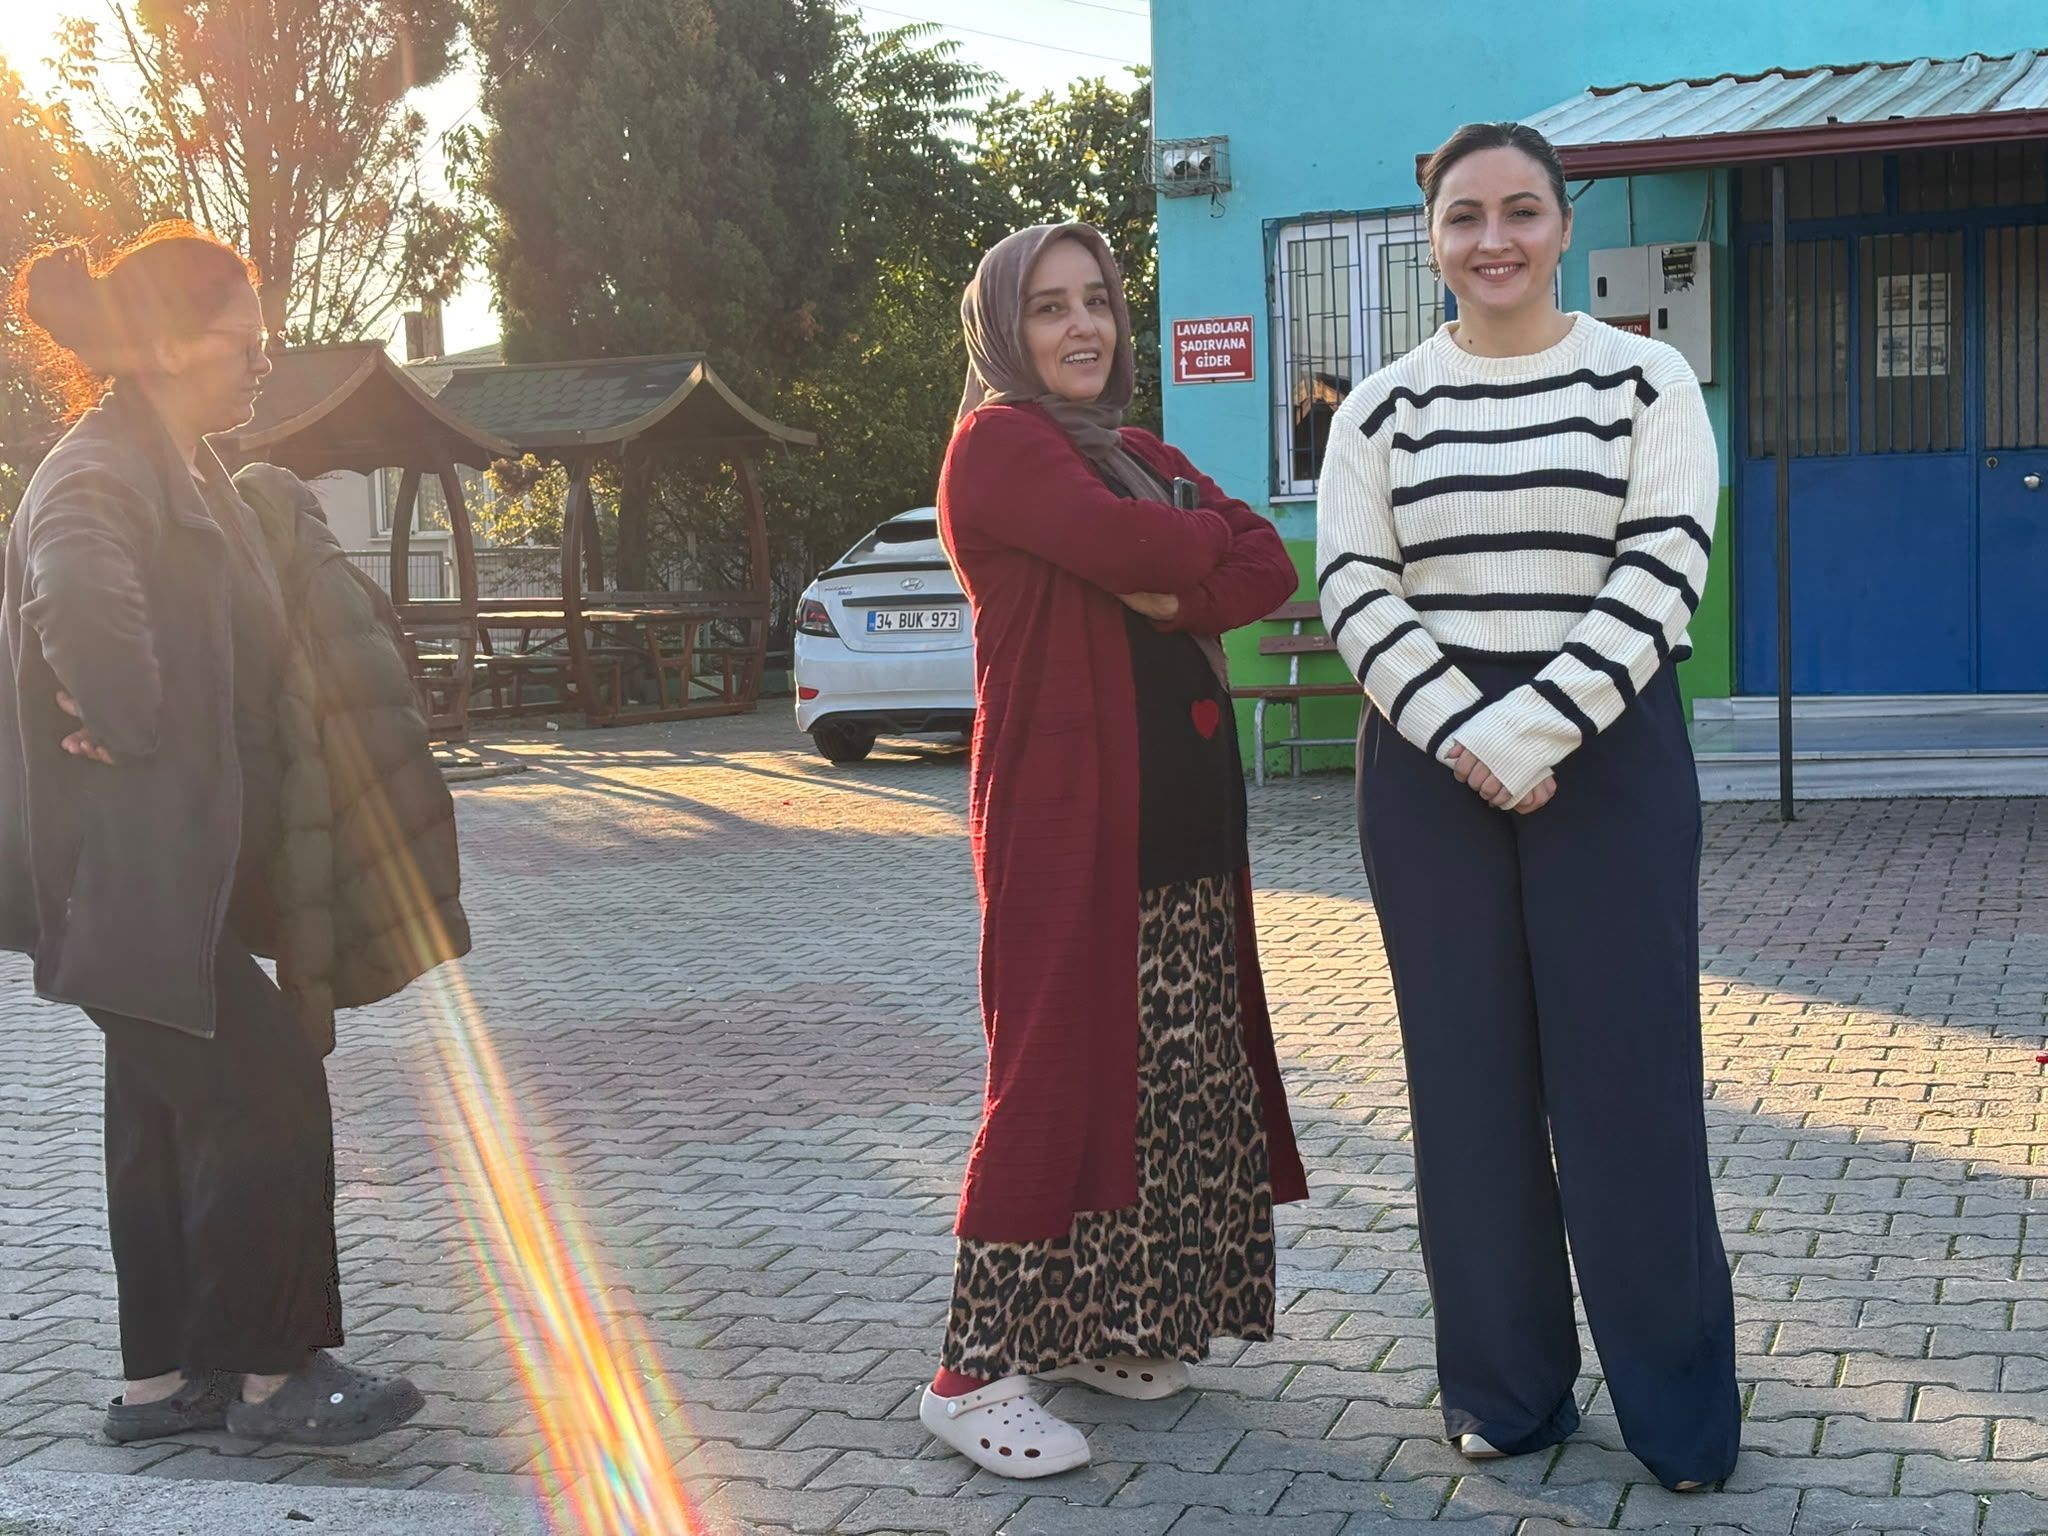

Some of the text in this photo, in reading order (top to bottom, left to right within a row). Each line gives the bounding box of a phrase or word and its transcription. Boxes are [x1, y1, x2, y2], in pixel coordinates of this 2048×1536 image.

[1176, 321, 1249, 336] LAVABOLARA
[1180, 338, 1246, 354] ŞADIRVANA
[1195, 352, 1232, 368] GİDER
[876, 612, 957, 629] 34 BUK 973
